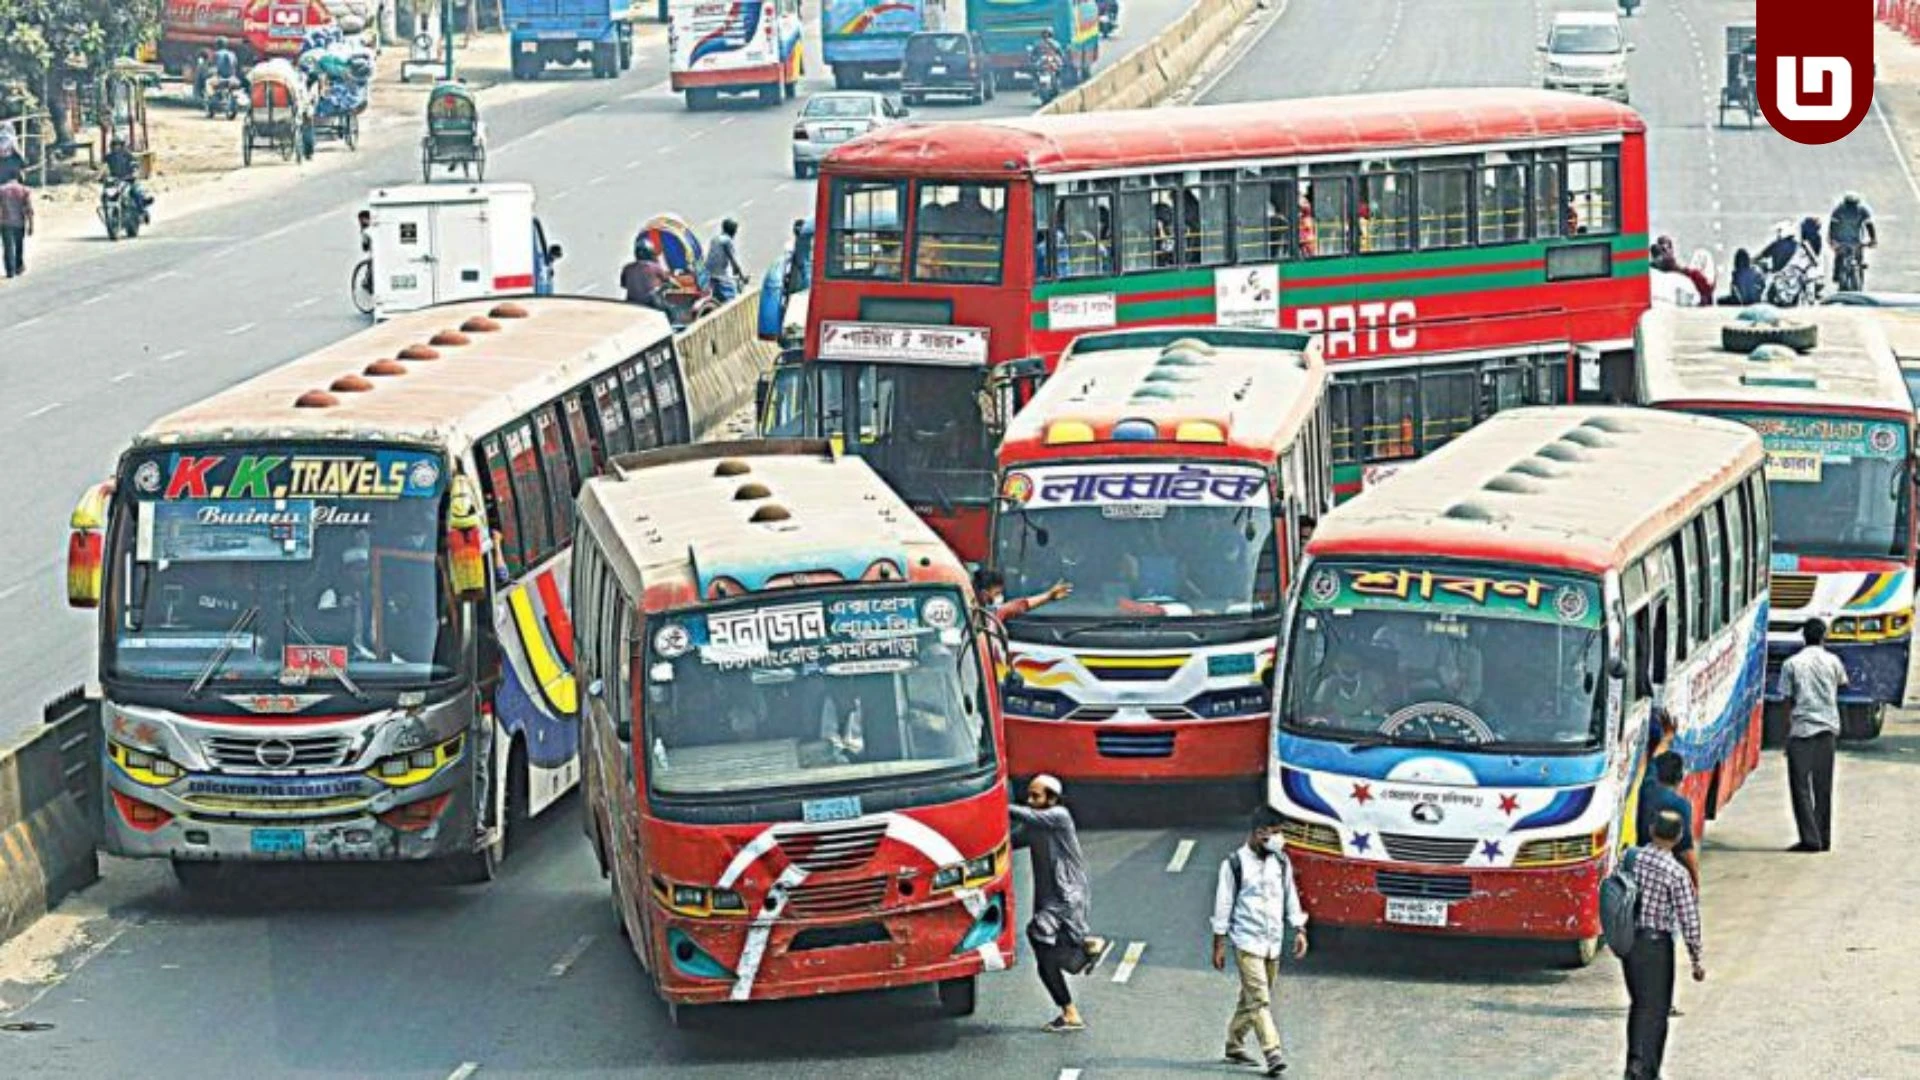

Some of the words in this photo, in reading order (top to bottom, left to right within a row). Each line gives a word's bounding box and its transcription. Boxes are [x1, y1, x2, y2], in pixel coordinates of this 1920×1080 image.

[287, 459, 407, 496] TRAVELS
[197, 505, 300, 524] Business
[309, 505, 372, 527] Class
[1345, 569, 1552, 608] শ্রাবণ
